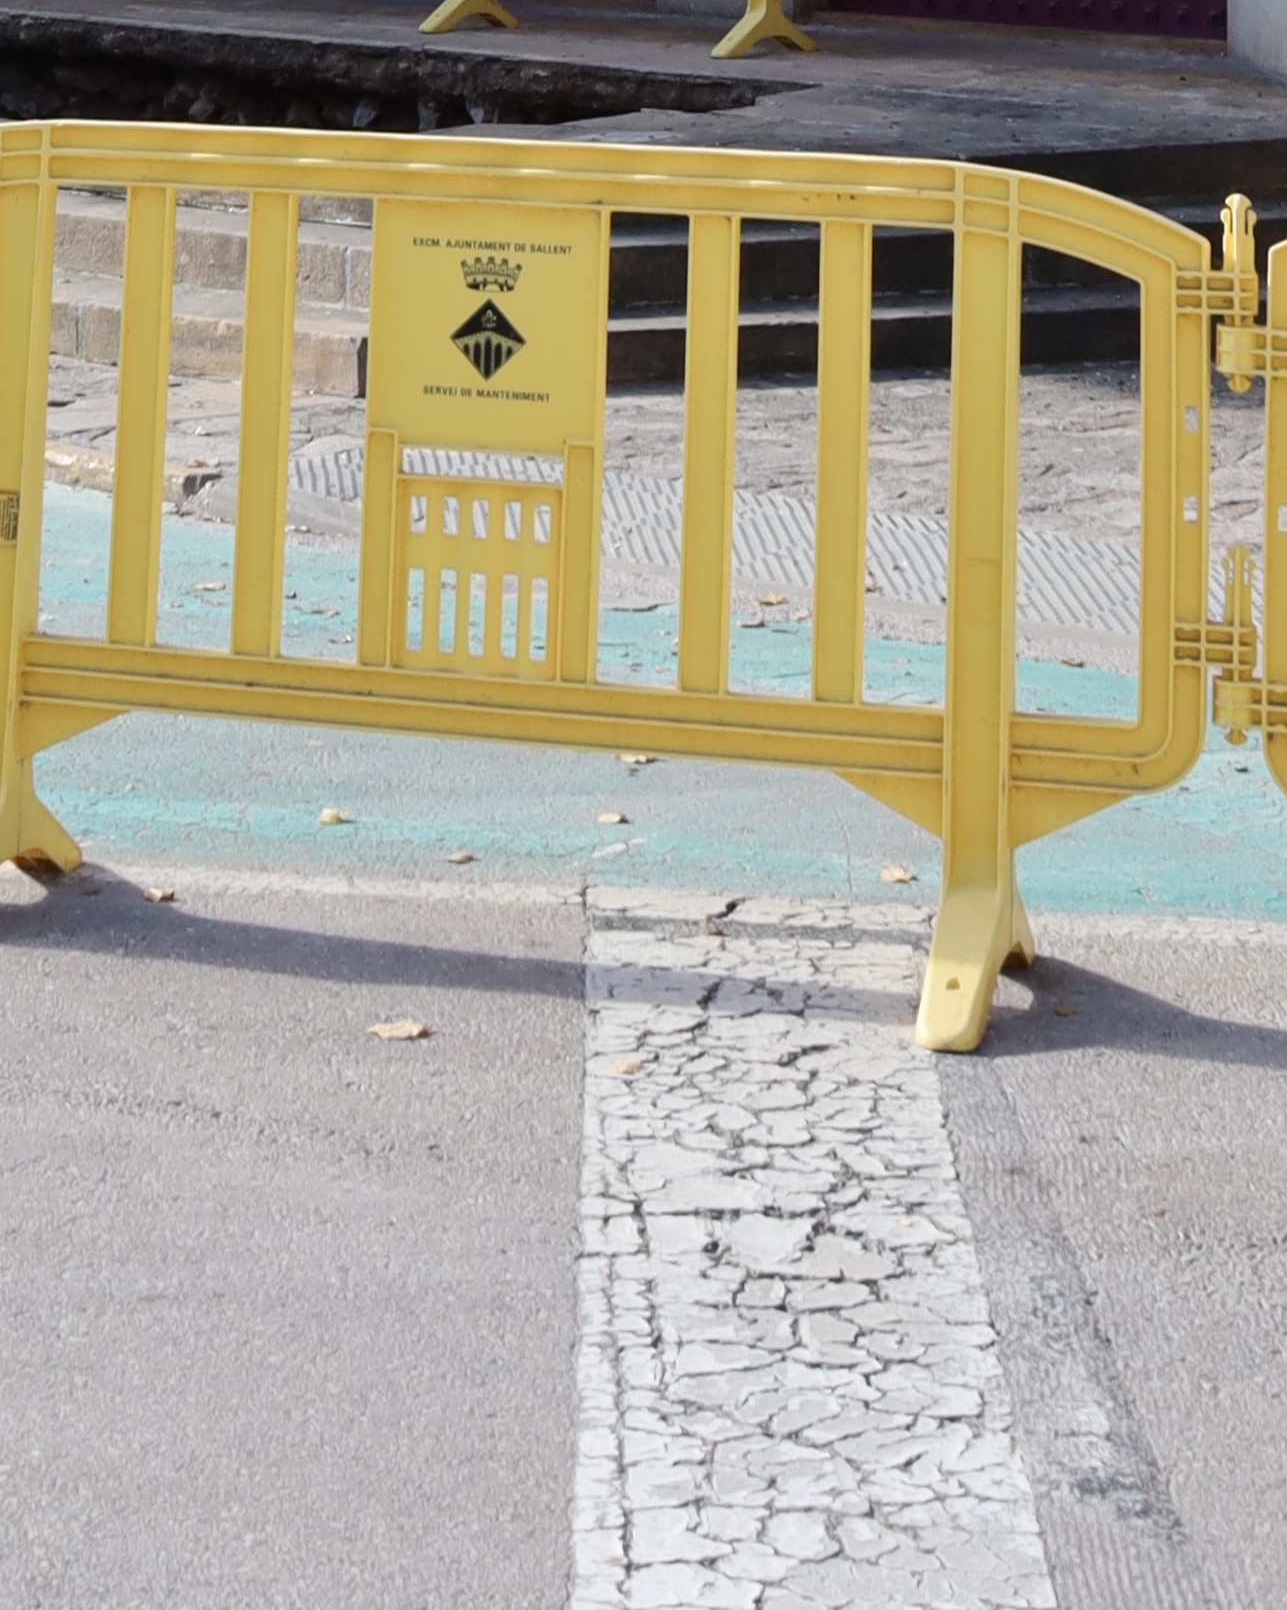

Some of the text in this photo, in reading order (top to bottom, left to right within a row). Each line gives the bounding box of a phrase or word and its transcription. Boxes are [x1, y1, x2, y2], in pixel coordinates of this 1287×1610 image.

[446, 239, 511, 252] AJUNTAMENT
[514, 243, 527, 252] DE
[530, 245, 572, 255] SALLENT
[423, 385, 550, 402] SERVEI DE MANTENIMENT
